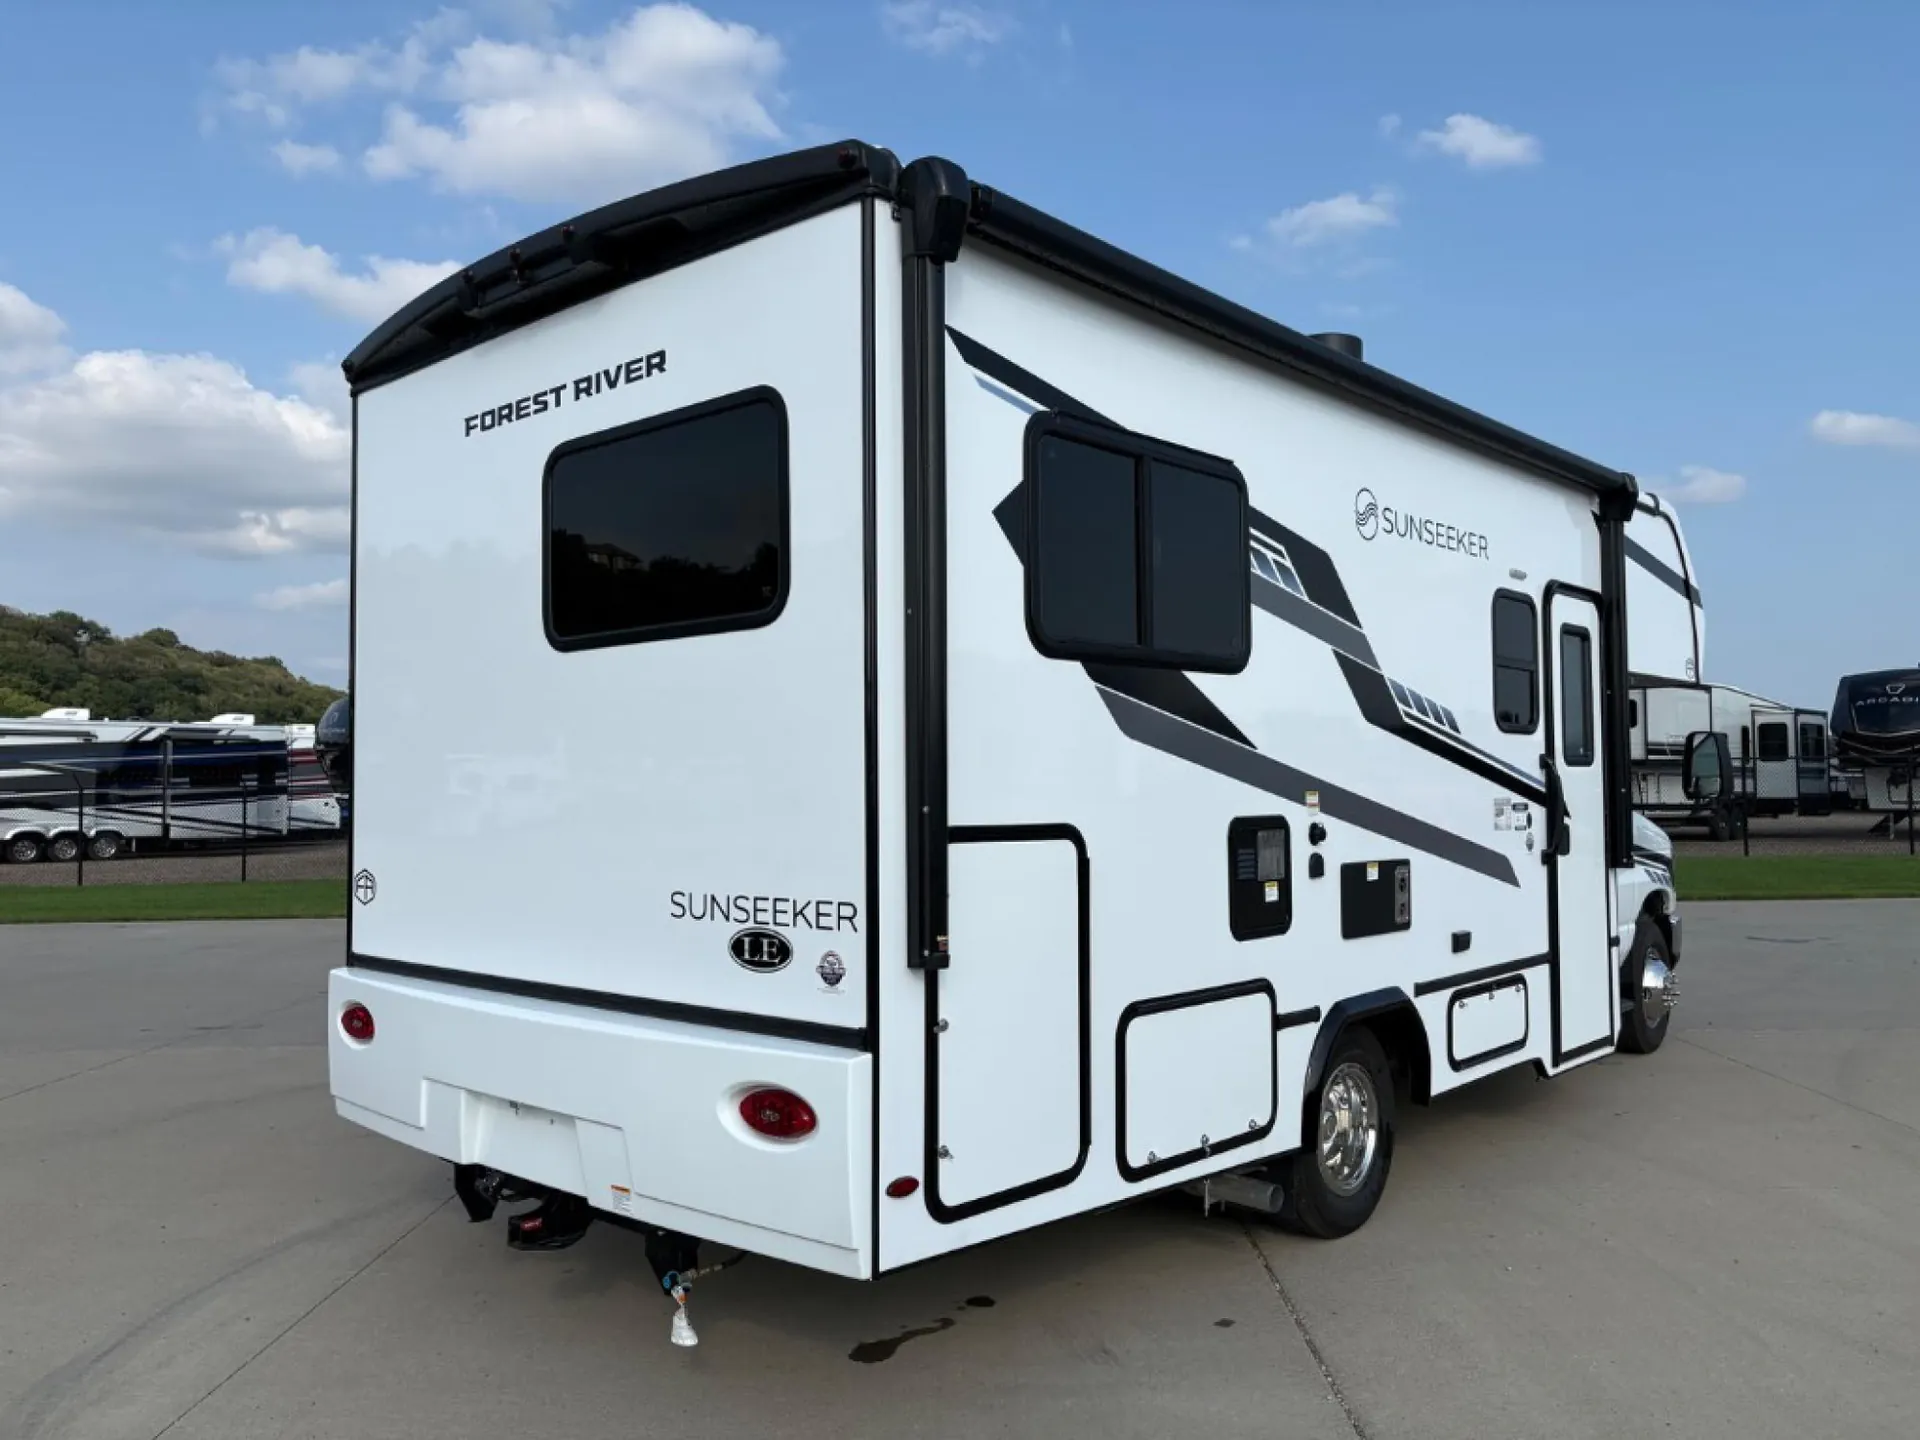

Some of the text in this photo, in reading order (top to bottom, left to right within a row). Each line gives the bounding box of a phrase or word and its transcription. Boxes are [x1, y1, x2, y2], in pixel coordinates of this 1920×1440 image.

[464, 349, 667, 437] FOREST RIVER
[1382, 507, 1489, 560] SUNSEEKER
[670, 890, 858, 933] SUNSEEKER
[741, 936, 781, 964] LE
